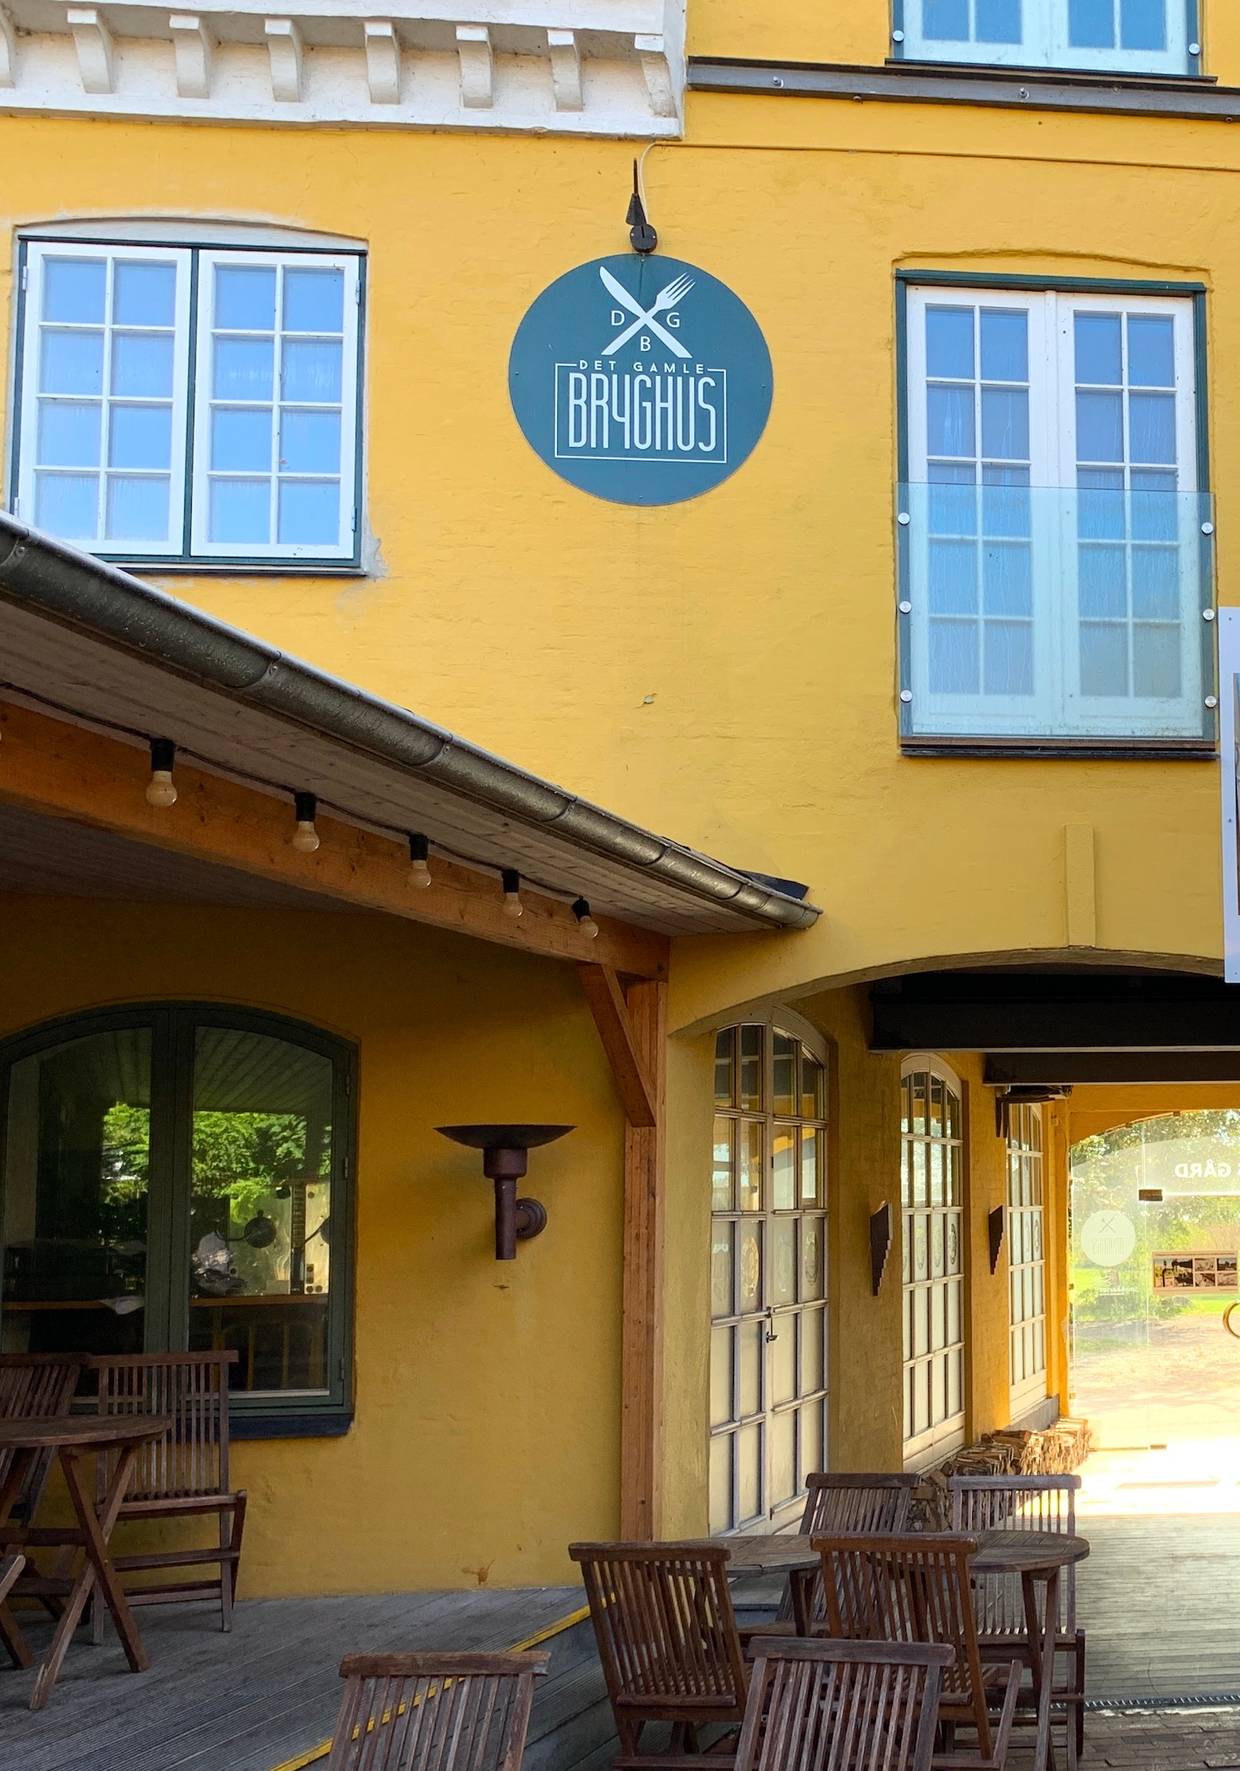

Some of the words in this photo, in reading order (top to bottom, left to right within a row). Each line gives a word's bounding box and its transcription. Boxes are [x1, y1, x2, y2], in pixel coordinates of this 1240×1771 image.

[611, 310, 625, 326] D
[666, 312, 681, 328] G
[640, 336, 651, 352] B
[579, 360, 617, 371] DET
[633, 362, 704, 374] GAMLE
[568, 372, 717, 452] BRYGHUS
